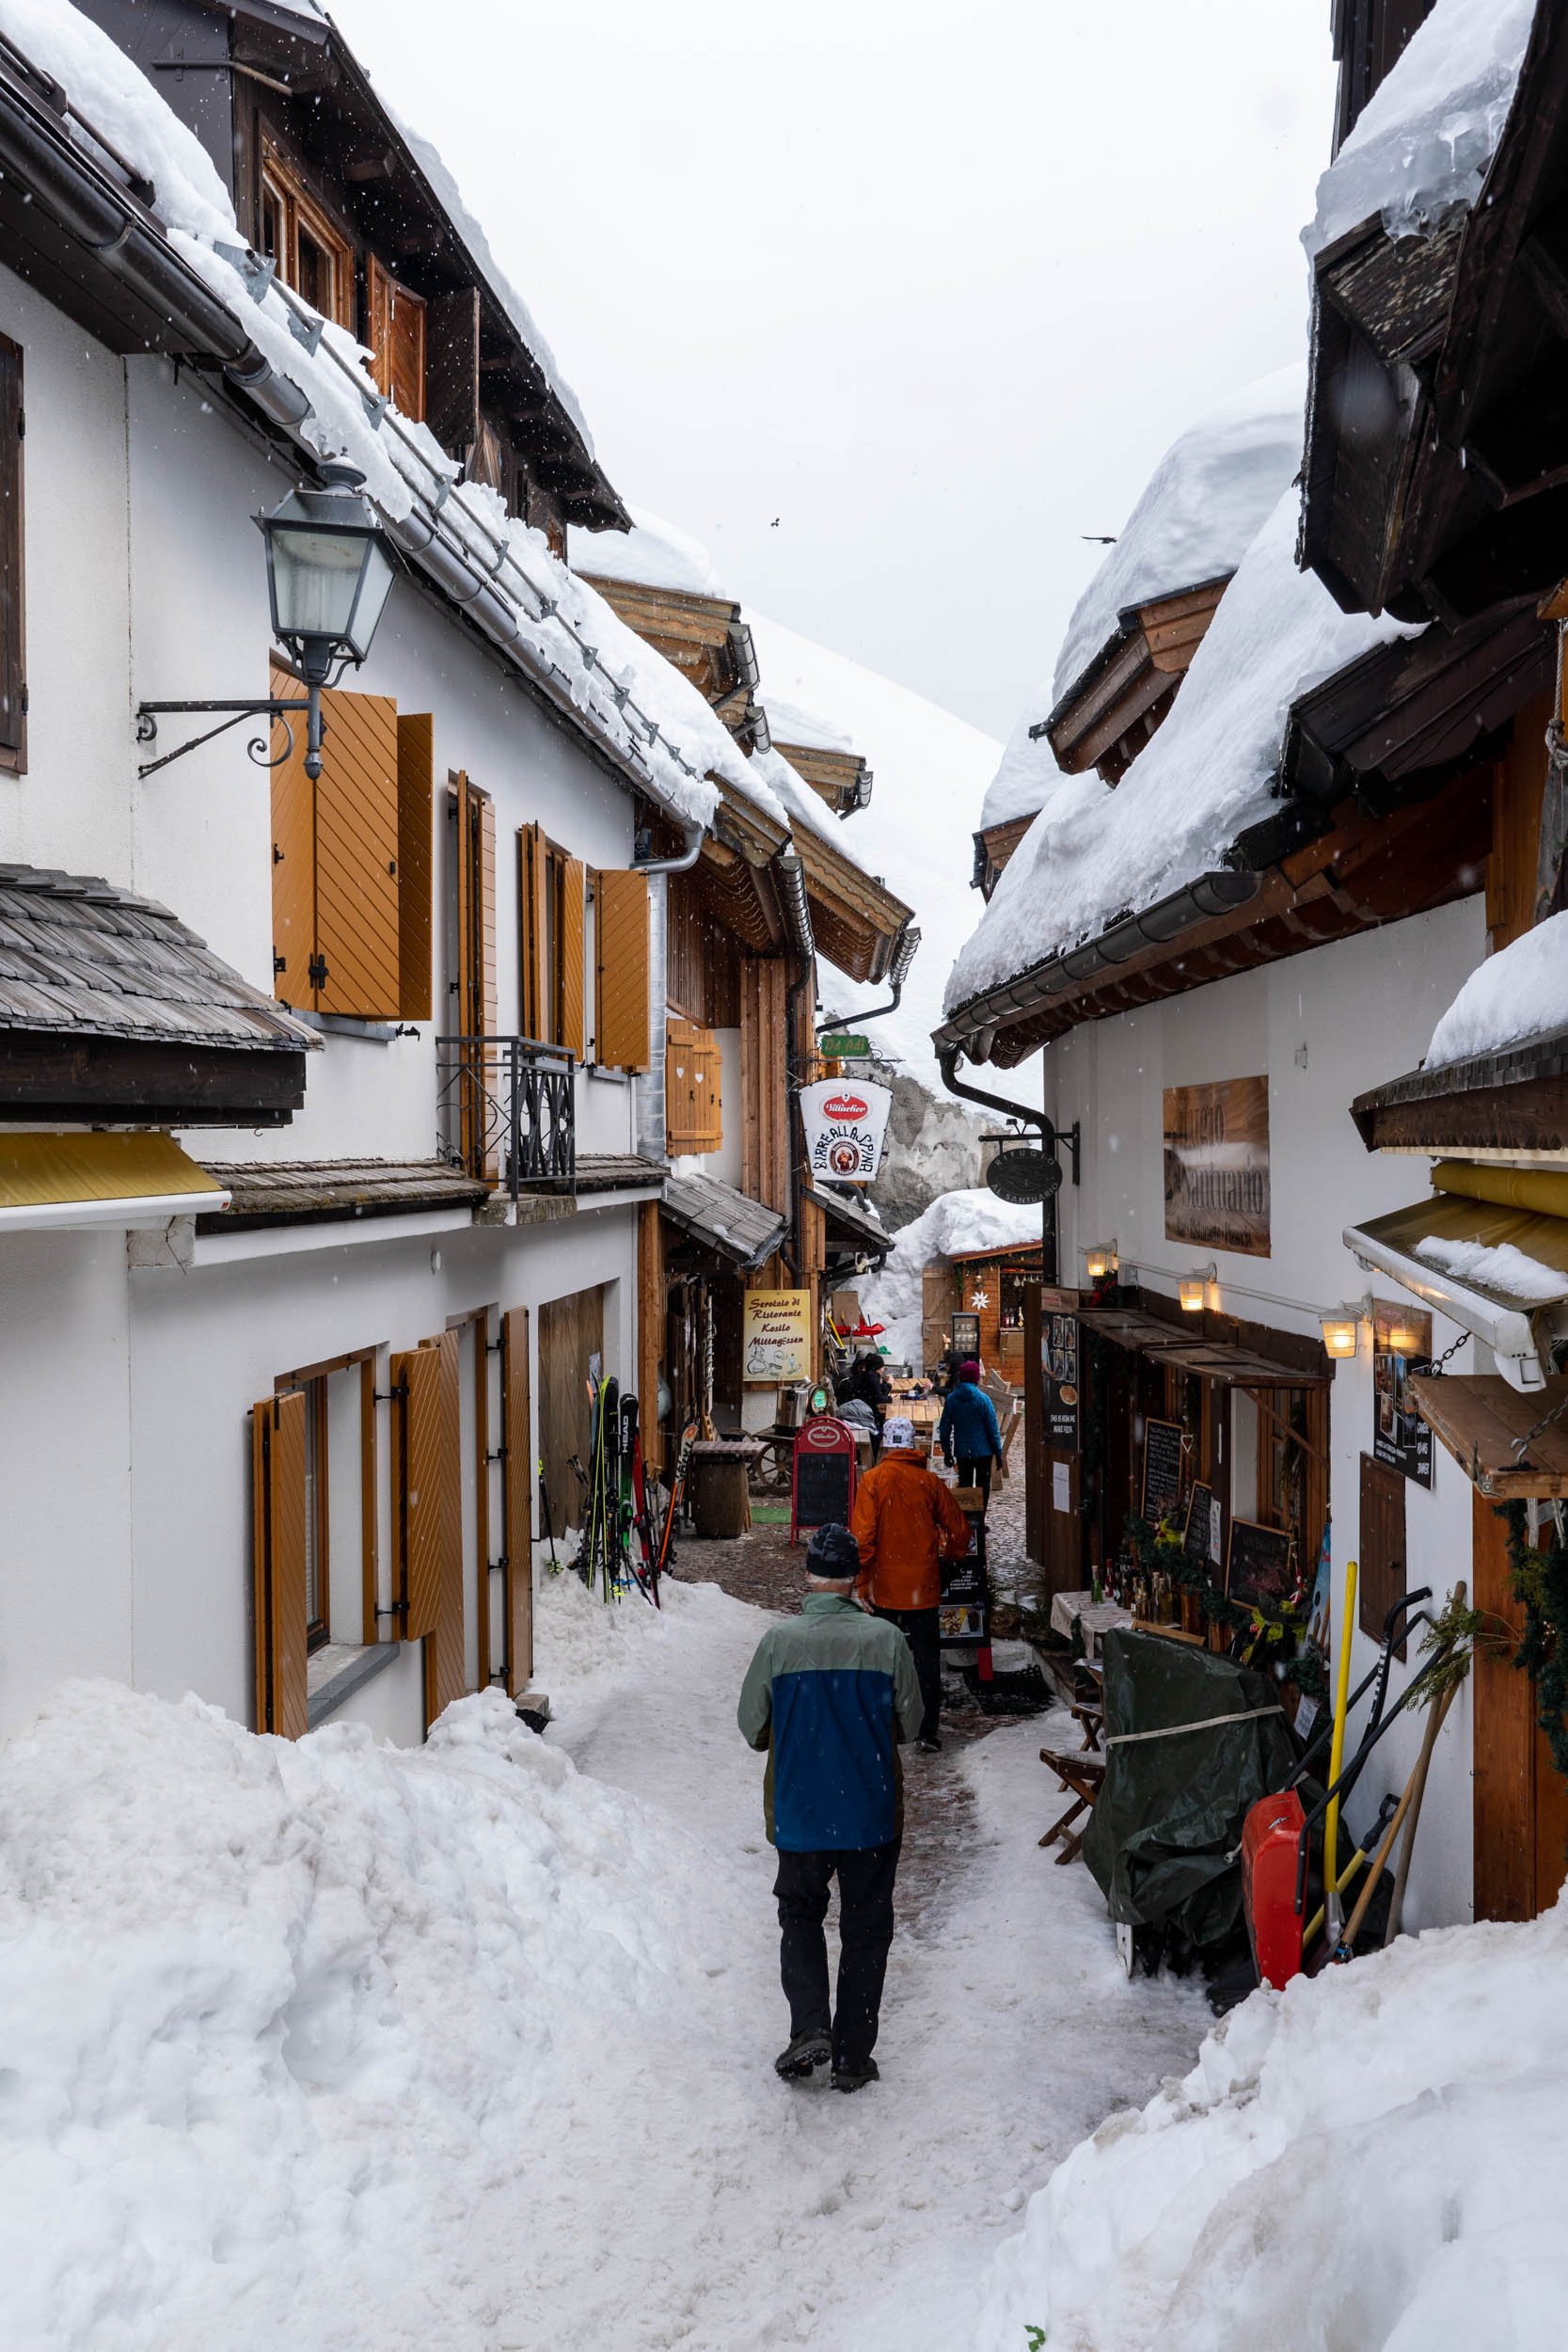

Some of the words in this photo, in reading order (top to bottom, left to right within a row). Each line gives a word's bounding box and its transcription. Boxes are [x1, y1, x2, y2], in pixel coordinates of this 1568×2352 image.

[826, 1103, 865, 1113] Villacher
[830, 1125, 858, 1143] ALLA
[994, 1150, 1054, 1167] RIFUGIO
[990, 1184, 1002, 1195] AL
[1005, 1183, 1058, 1203] SANTUARIO
[791, 1297, 800, 1307] di
[752, 1309, 802, 1321] Ristorante
[761, 1323, 791, 1333] Kosilo
